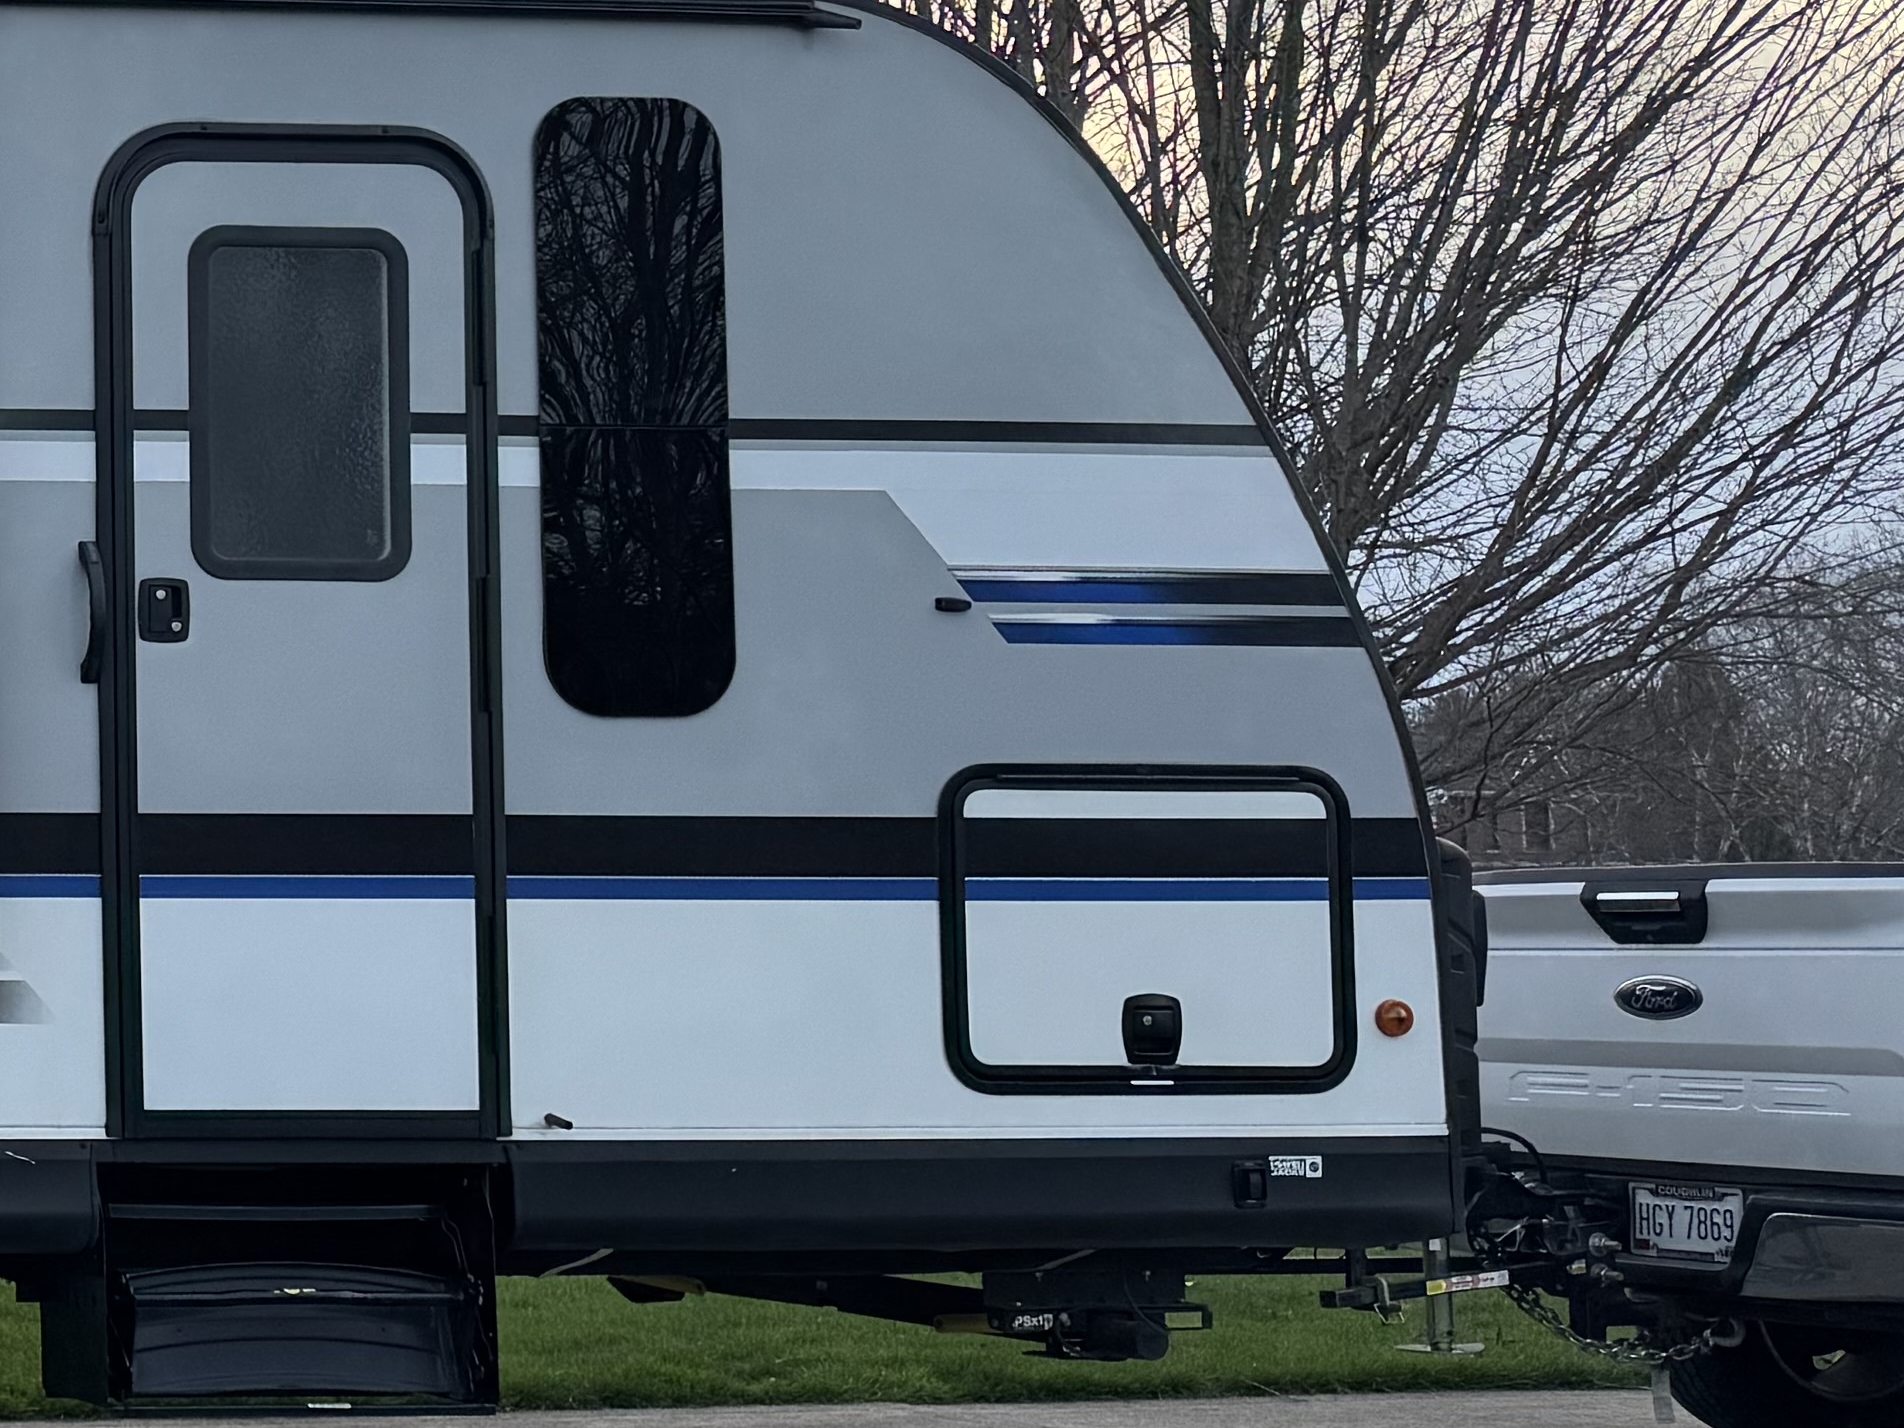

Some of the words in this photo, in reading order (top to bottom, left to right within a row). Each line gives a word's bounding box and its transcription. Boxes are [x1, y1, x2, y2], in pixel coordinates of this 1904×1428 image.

[1631, 984, 1679, 1010] Ford
[1505, 1070, 1852, 1116] F-150
[1657, 1185, 1714, 1198] COUGHLIN
[1638, 1202, 1676, 1239] HGY
[1684, 1204, 1735, 1243] 7869
